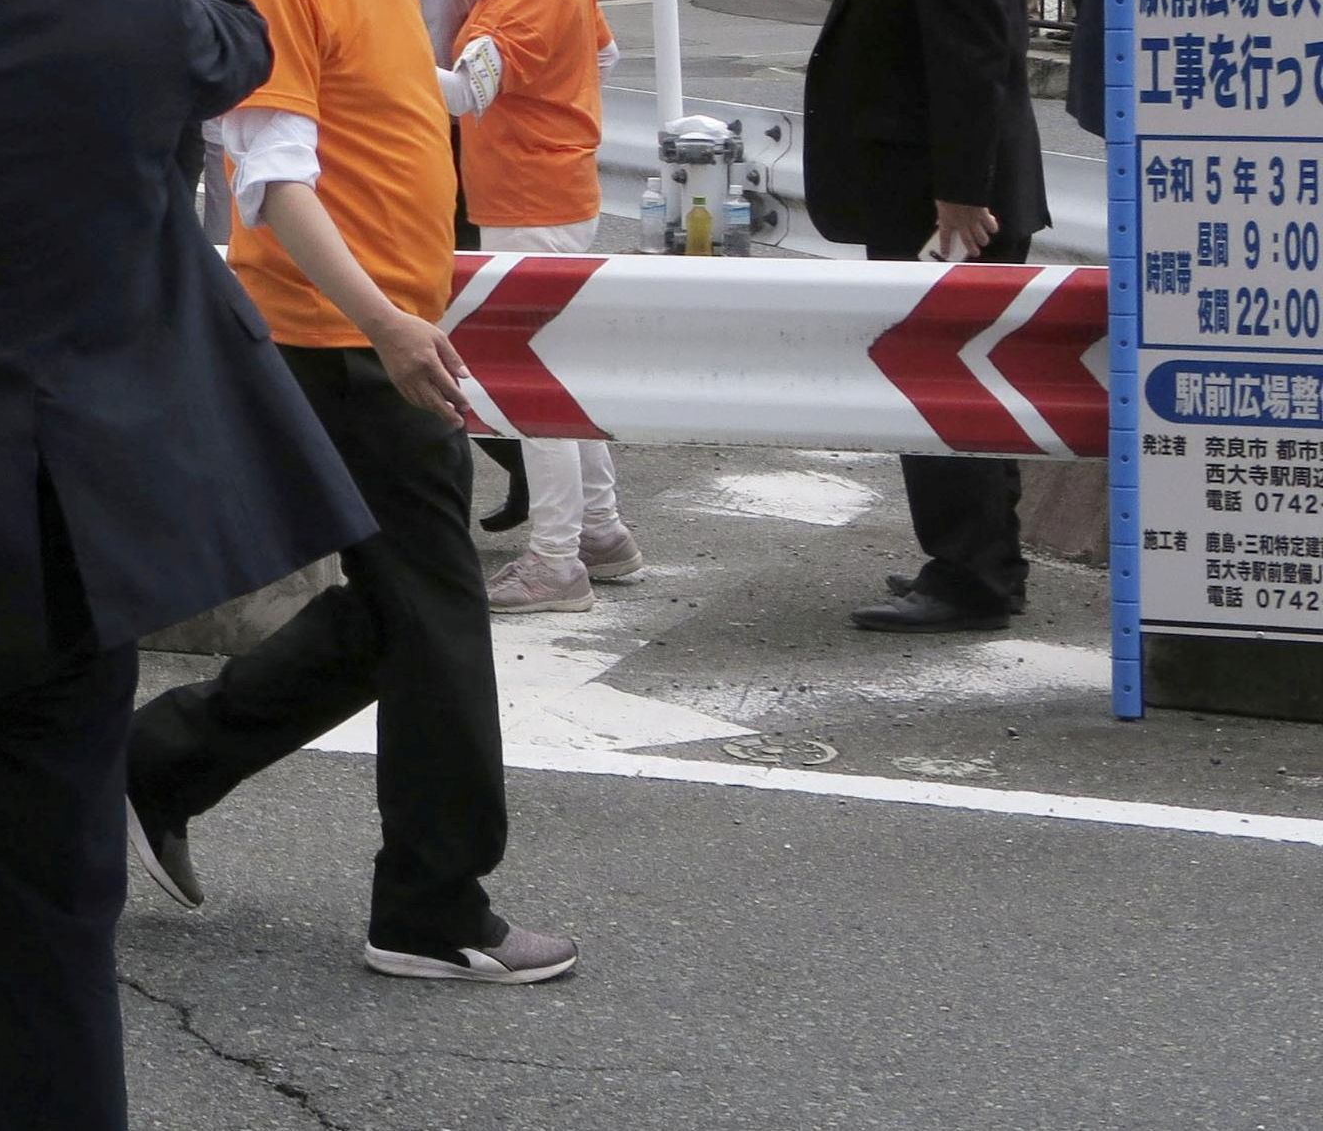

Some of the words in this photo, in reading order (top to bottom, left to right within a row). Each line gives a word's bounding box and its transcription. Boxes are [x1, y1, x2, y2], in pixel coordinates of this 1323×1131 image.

[1197, 222, 1229, 268] 昼間
[1146, 251, 1192, 295] 時間帯
[1197, 287, 1230, 334] 夜間
[1236, 287, 1320, 338] 22:00
[1175, 371, 1323, 420] 駅前広場整
[1143, 433, 1187, 457] 発注者
[1206, 436, 1269, 459] 奈良市
[1277, 439, 1323, 462] 都市
[1206, 489, 1243, 513] 電話
[1255, 492, 1323, 514] 0742
[1143, 529, 1188, 552] 施工者
[1206, 532, 1323, 558] 鹿島・三和特定建
[1207, 585, 1244, 609] 電話
[1256, 588, 1323, 611] 0742
